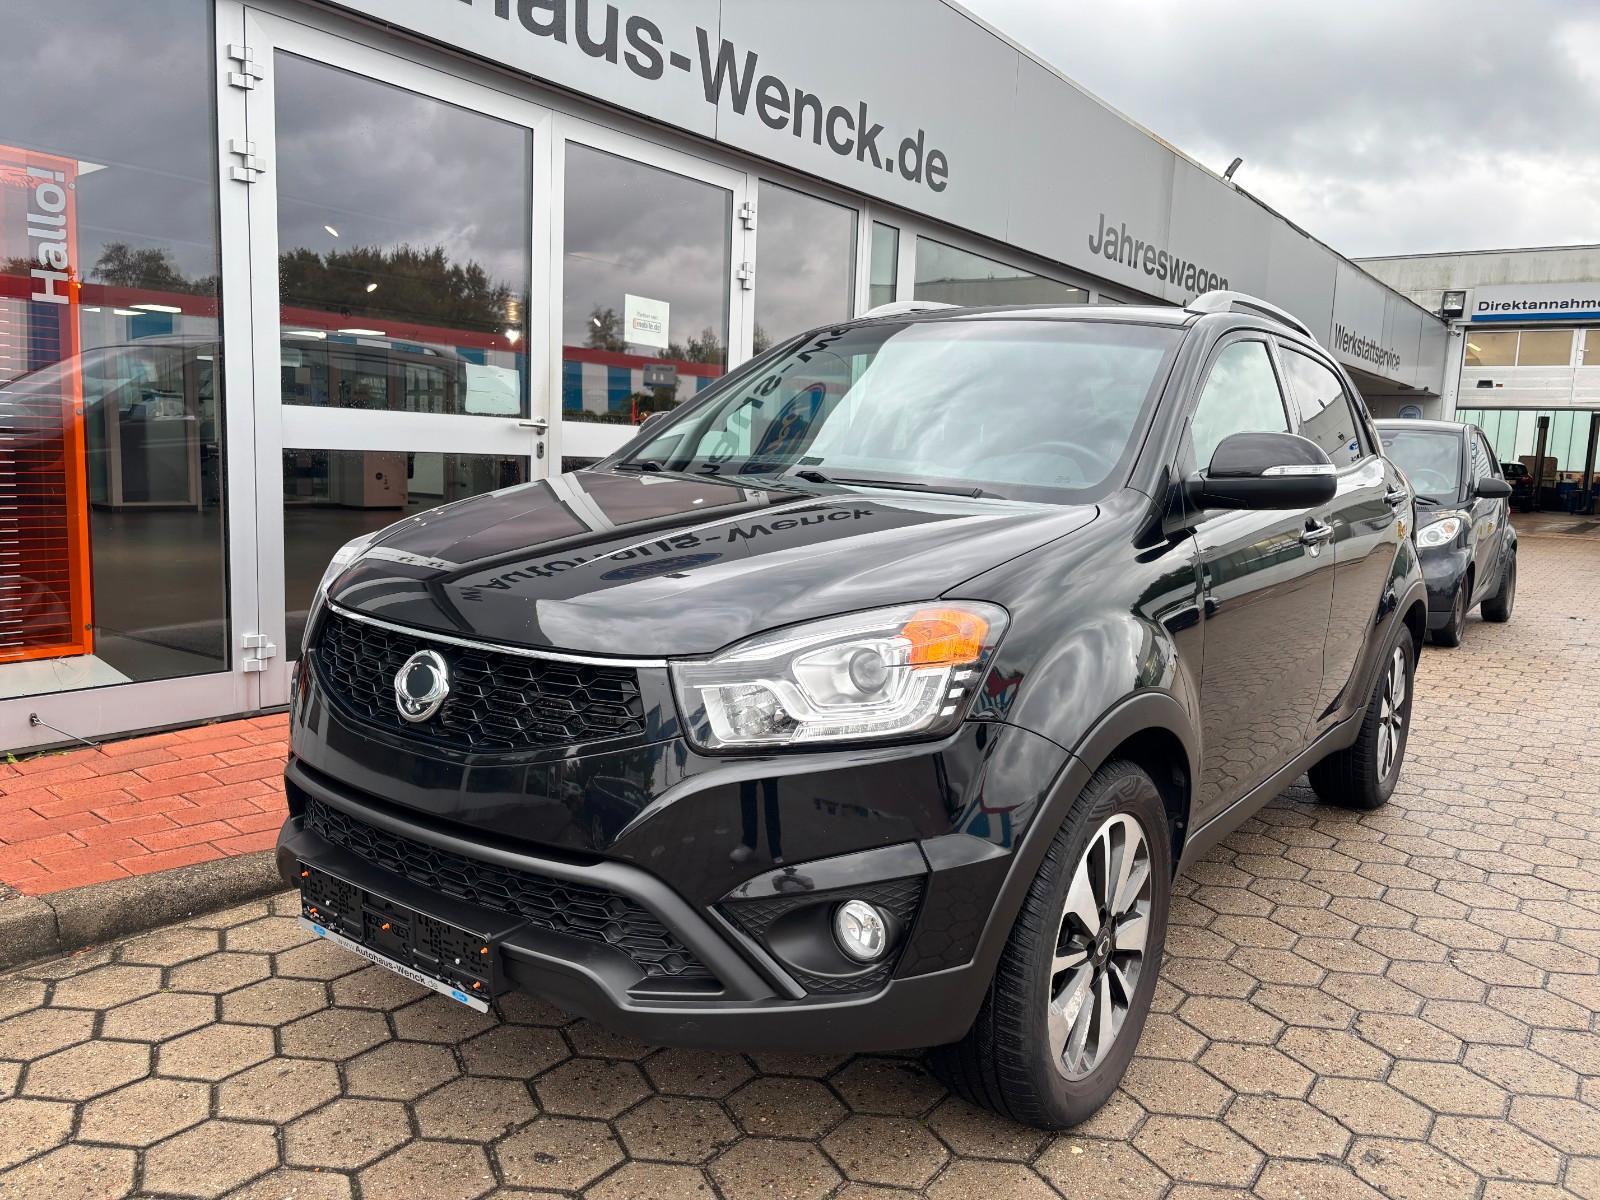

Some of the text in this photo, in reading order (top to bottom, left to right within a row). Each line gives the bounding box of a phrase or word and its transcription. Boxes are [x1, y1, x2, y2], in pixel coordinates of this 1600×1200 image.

[459, 0, 949, 193] aus-Wenck.de
[27, 166, 70, 305] Hallo!
[1088, 213, 1229, 299] Jahreswagen
[1334, 322, 1401, 367] Werkstattservice
[1478, 298, 1600, 312] Direktannahm
